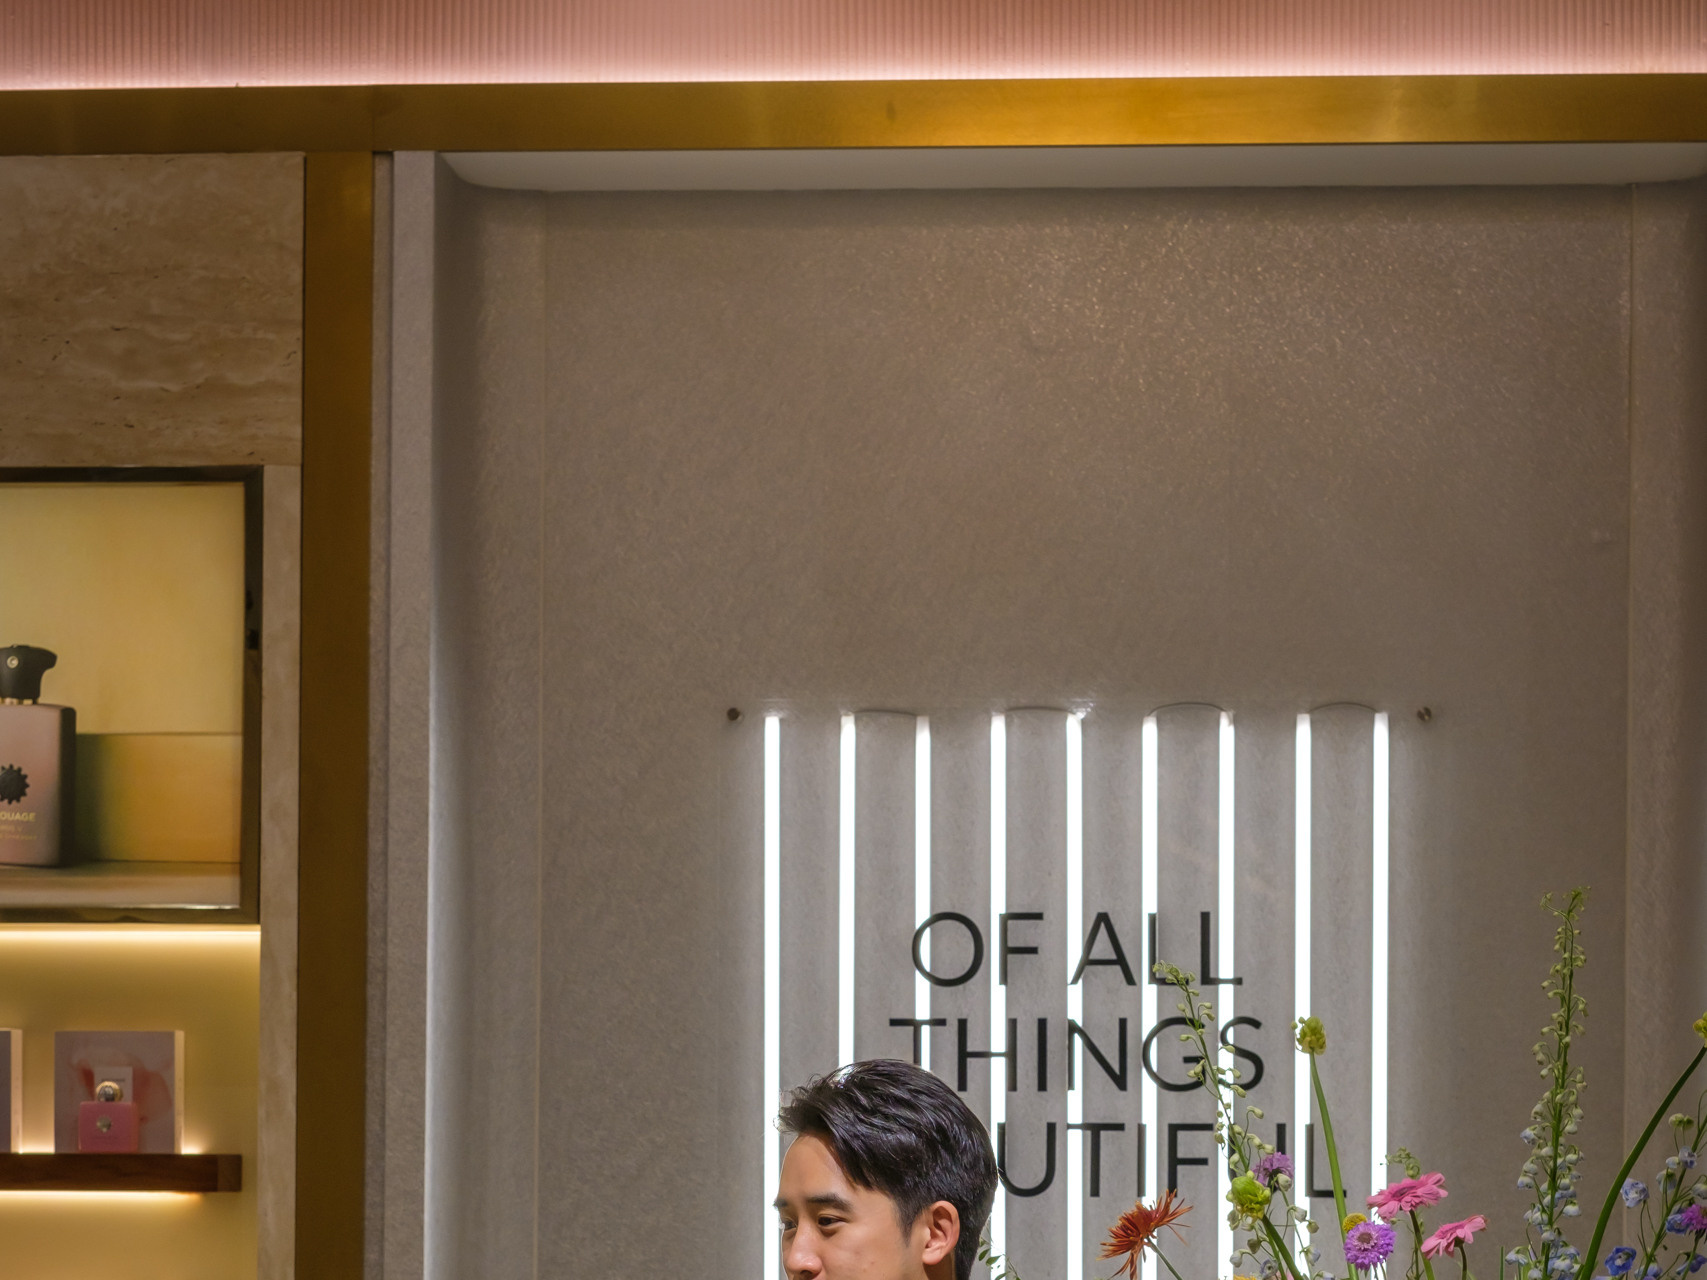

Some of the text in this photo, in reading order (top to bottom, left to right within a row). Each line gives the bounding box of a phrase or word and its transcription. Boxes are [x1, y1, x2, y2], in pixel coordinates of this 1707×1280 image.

[0, 811, 36, 822] OUAGE
[911, 911, 1244, 987] OF ALL
[889, 1016, 1265, 1093] THINGS
[996, 1122, 1347, 1199] UTIFL
